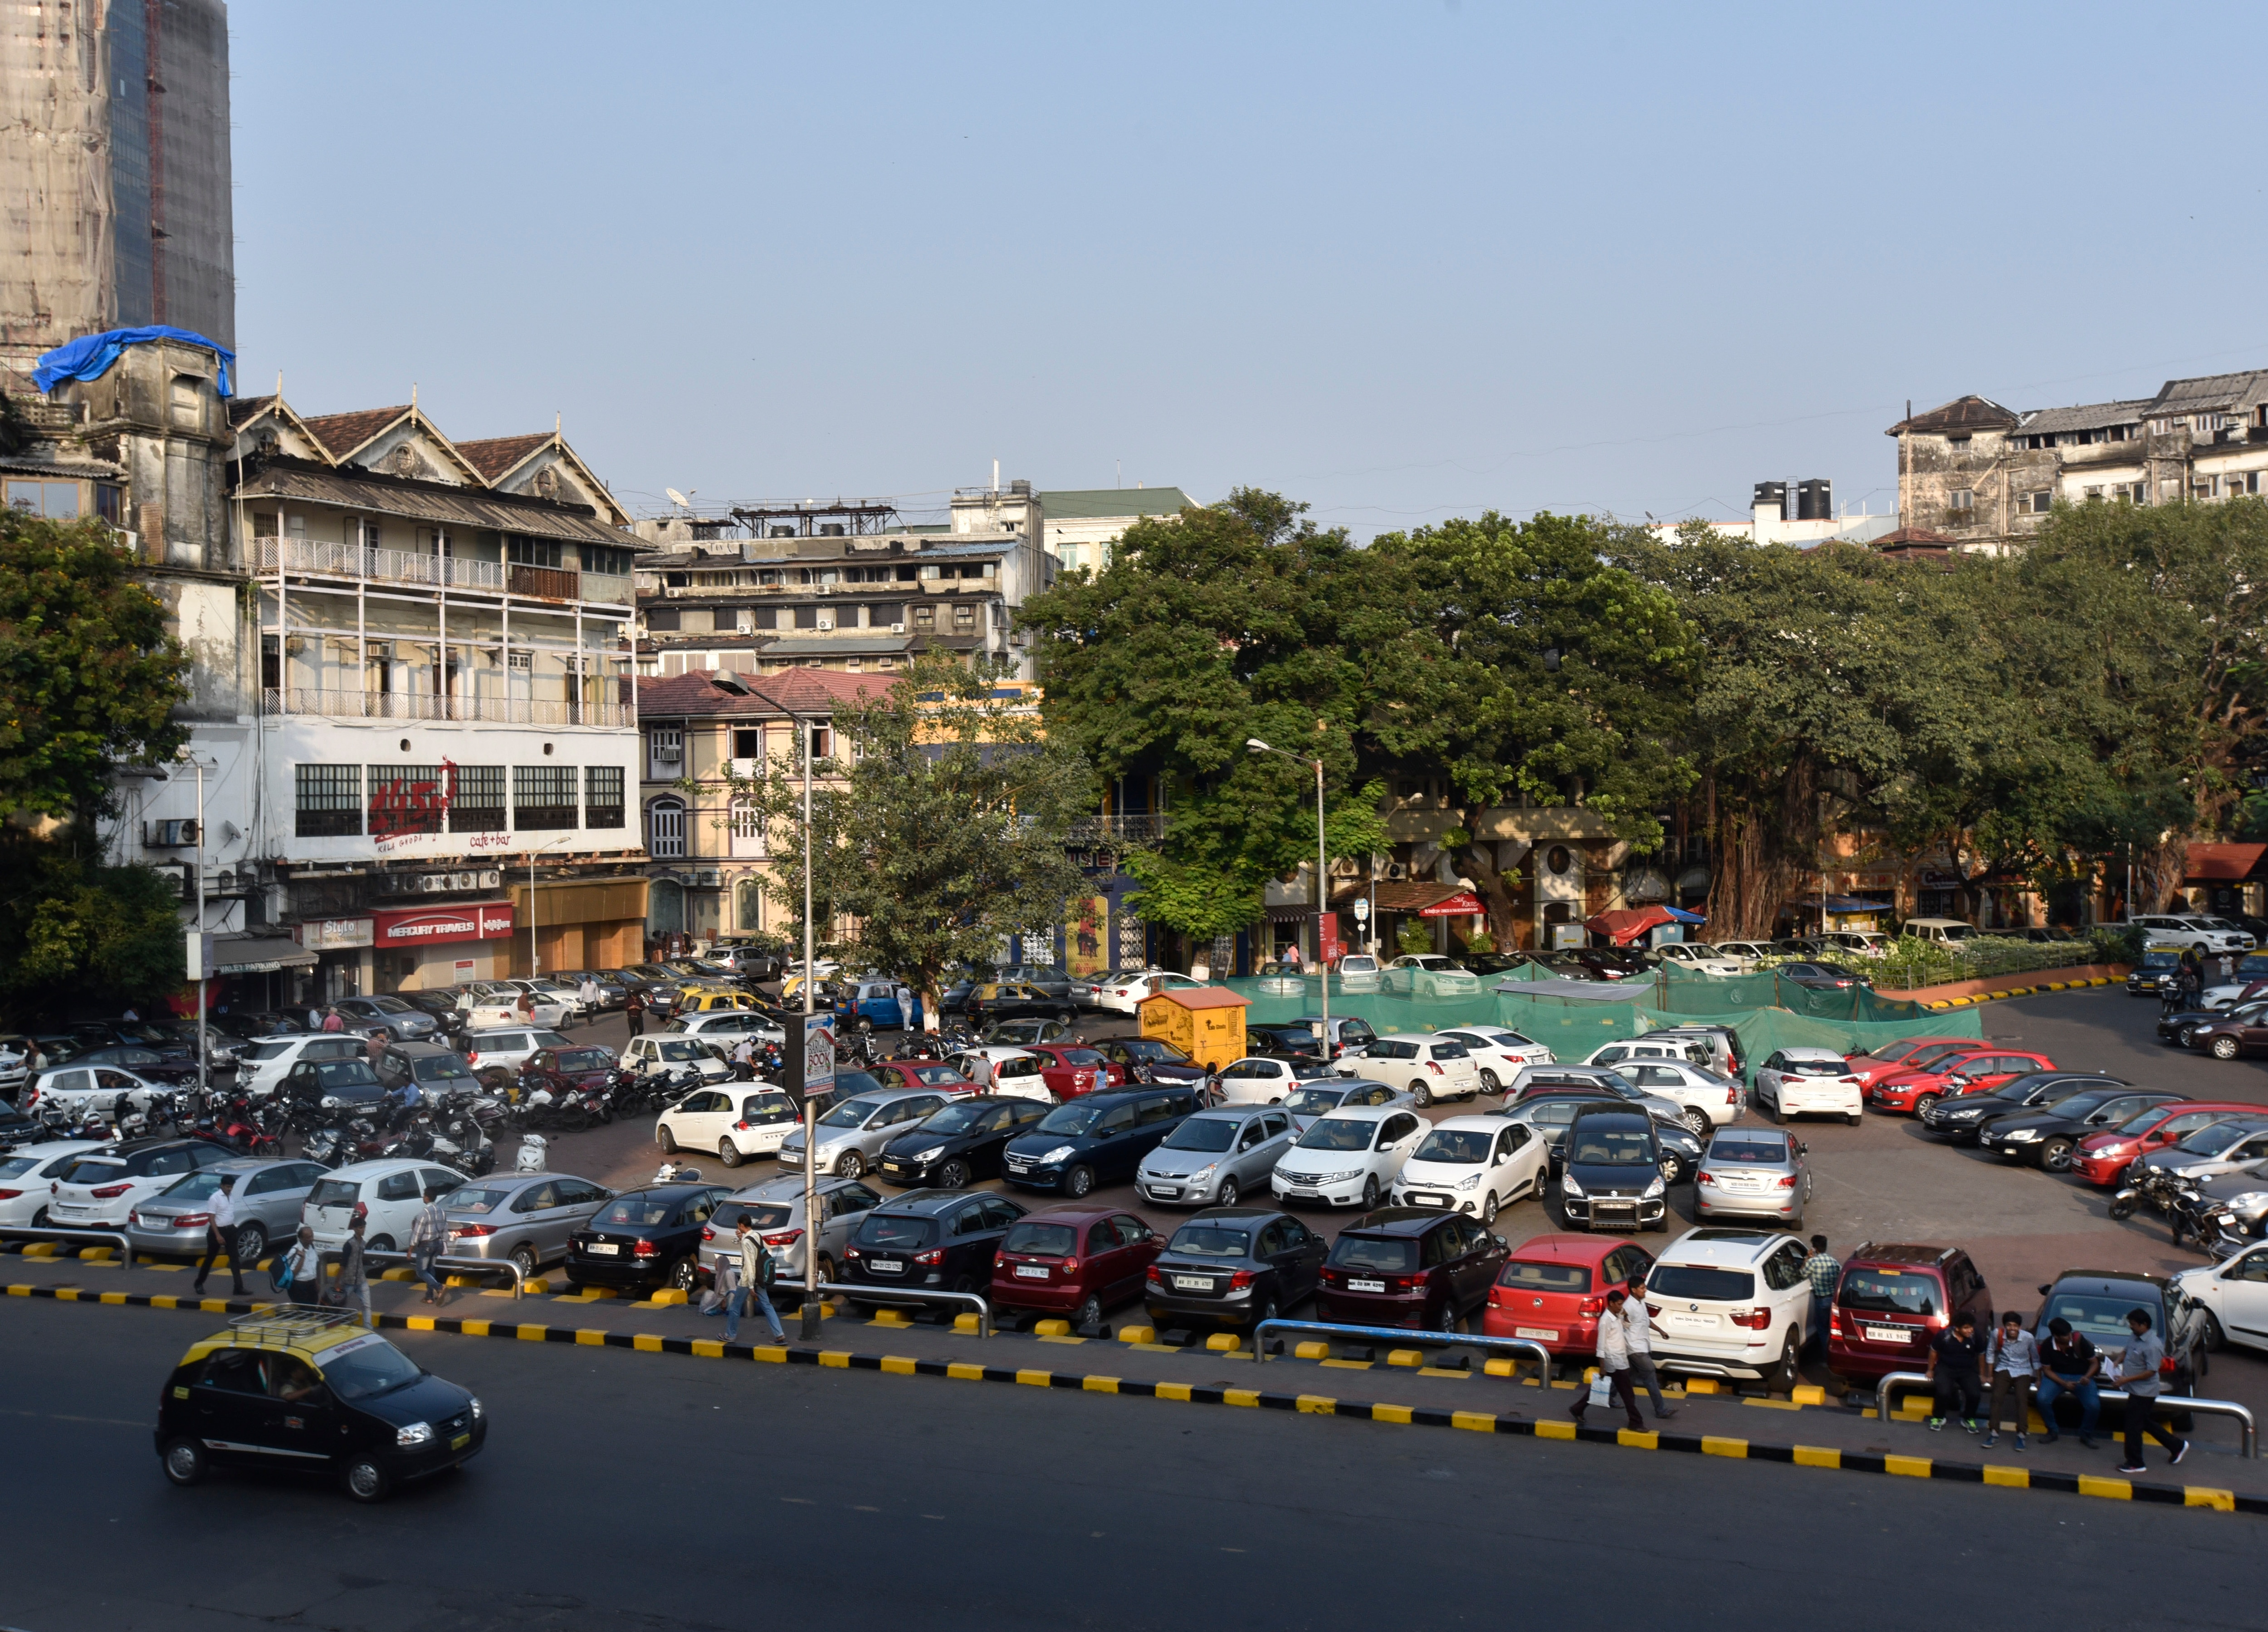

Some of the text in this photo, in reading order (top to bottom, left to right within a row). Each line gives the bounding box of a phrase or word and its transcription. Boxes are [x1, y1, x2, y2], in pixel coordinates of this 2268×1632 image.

[378, 834, 422, 853] KALA GHODA
[325, 920, 354, 936] Stylo
[387, 922, 475, 938] MERCURY TRAVELS
[219, 961, 281, 973] VALET PARKING
[1076, 963, 1098, 975] BEATLES
[808, 1036, 831, 1054] BARGAIN
[808, 1051, 831, 1067] BOOK
[814, 1065, 825, 1076] HUT
